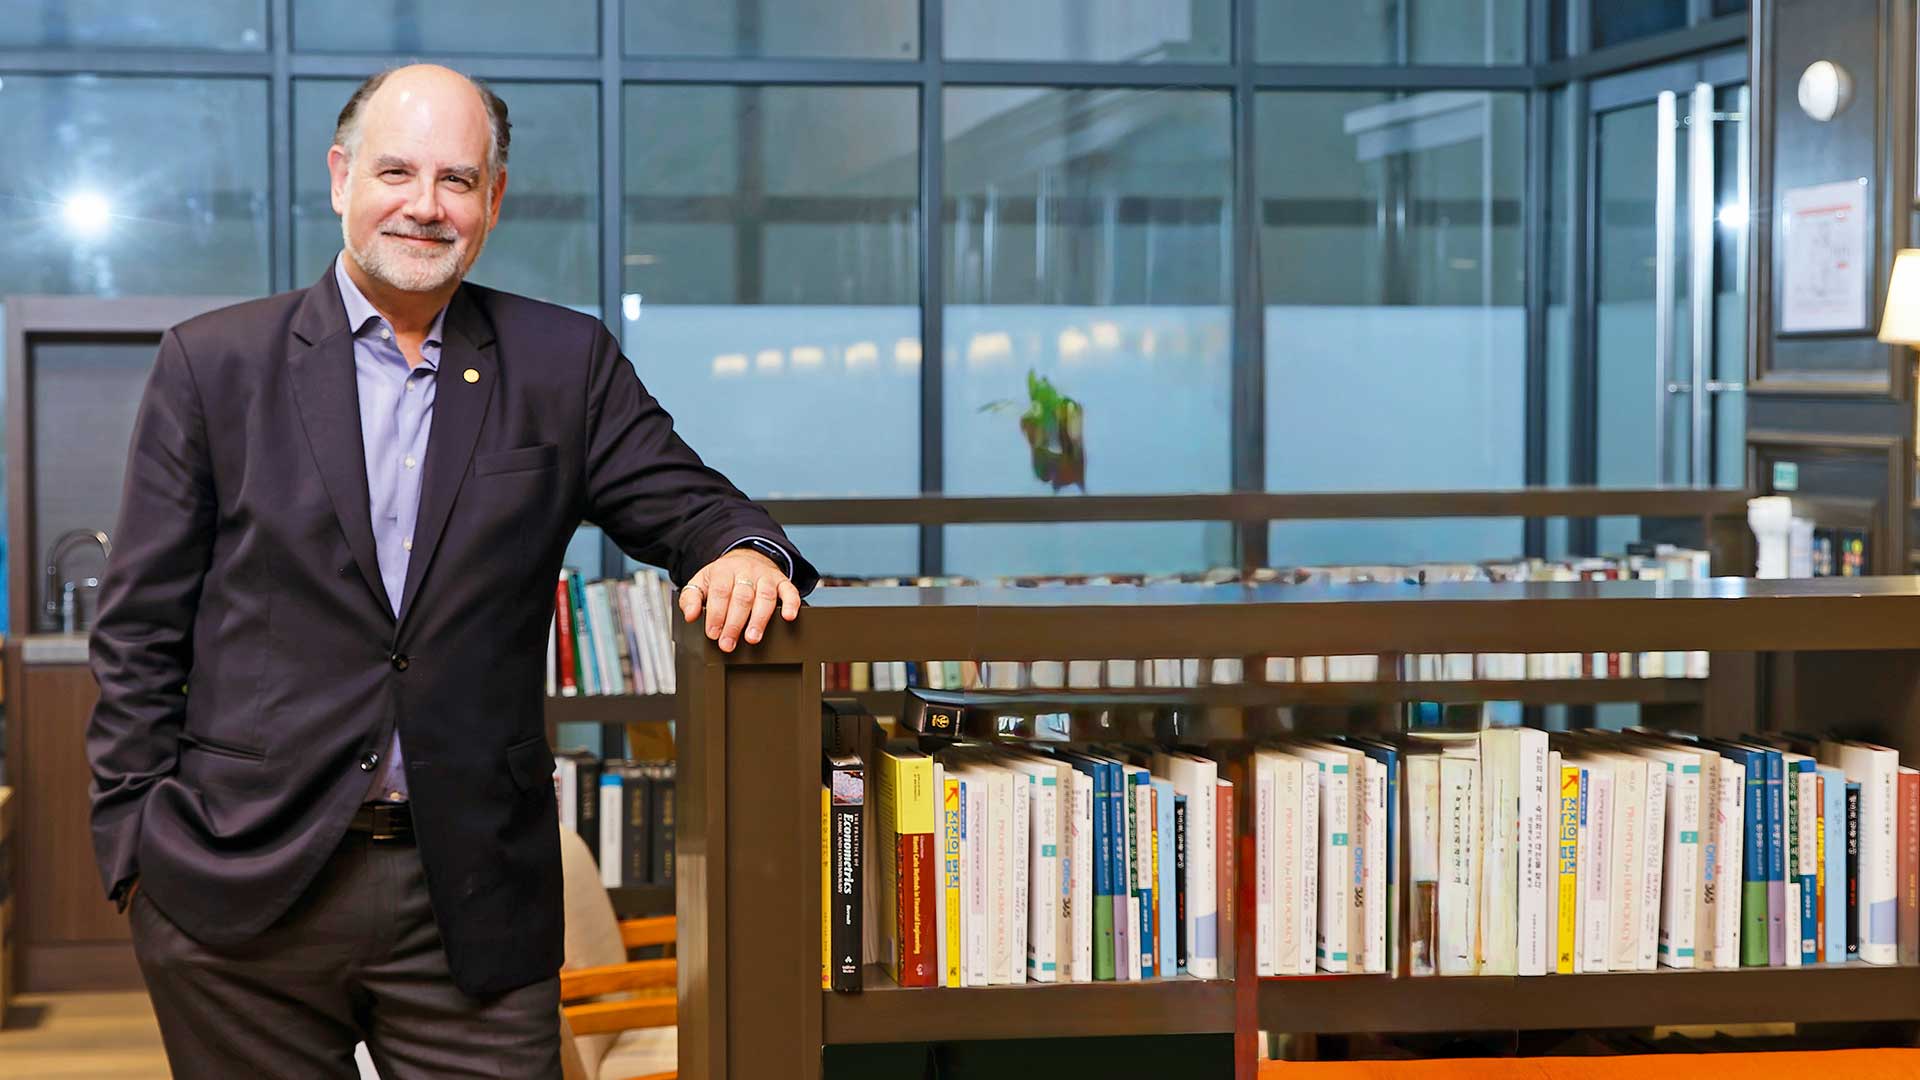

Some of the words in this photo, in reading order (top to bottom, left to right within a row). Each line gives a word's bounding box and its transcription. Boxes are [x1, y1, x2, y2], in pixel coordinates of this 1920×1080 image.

[843, 812, 855, 895] Econometrics
[912, 835, 921, 853] Monte
[912, 854, 921, 868] Carlo
[946, 859, 959, 888] 법칙
[1353, 846, 1363, 885] Office
[1560, 845, 1575, 874] 법칙
[1705, 844, 1716, 881] Office
[913, 868, 921, 891] Methods
[1062, 858, 1071, 895] Office
[1062, 898, 1071, 918] 365
[1353, 887, 1363, 908] 365
[1622, 873, 1632, 942] DEMOCRACY
[1704, 883, 1714, 904] 365
[913, 898, 921, 921] Financial
[913, 921, 921, 955] Engineering
